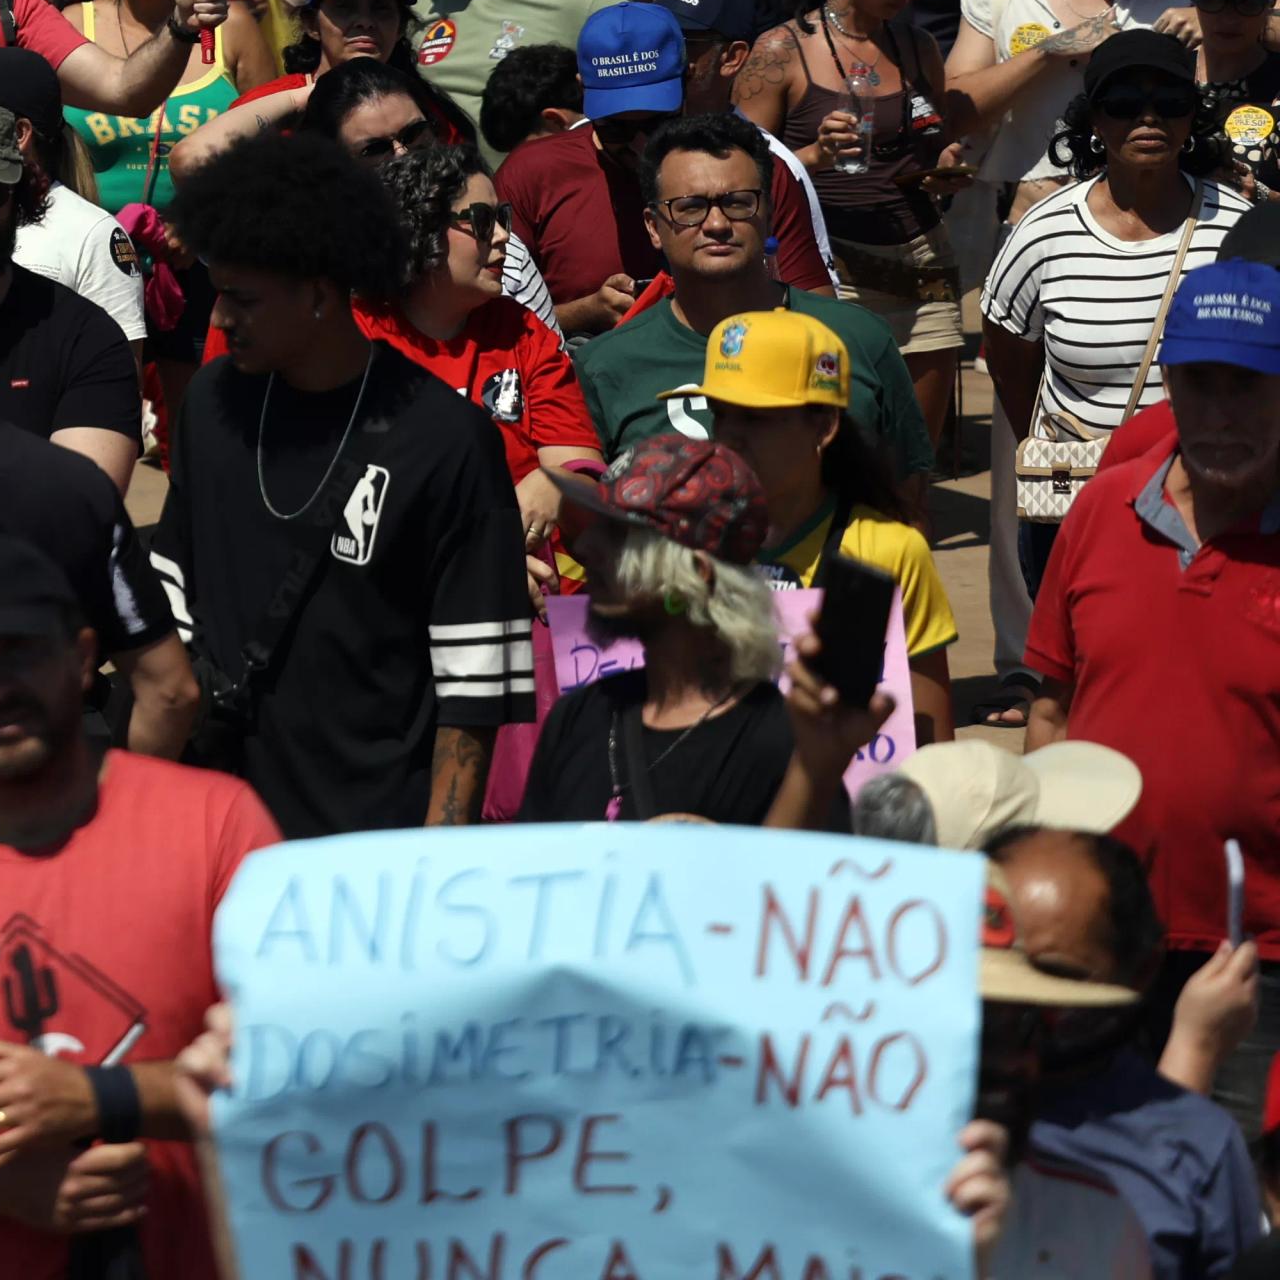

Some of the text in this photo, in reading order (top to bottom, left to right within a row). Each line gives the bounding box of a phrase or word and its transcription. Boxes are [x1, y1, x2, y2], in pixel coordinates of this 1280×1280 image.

[591, 49, 660, 67] O BRASIL É DOS
[597, 61, 657, 78] BRASILEIROS
[1193, 295, 1203, 307] O
[1202, 293, 1238, 306] BRASIL
[1241, 292, 1250, 307] É
[1196, 306, 1265, 326] BRASILEIROS
[336, 535, 357, 556] NBA
[260, 1112, 673, 1215] GOLPE,
